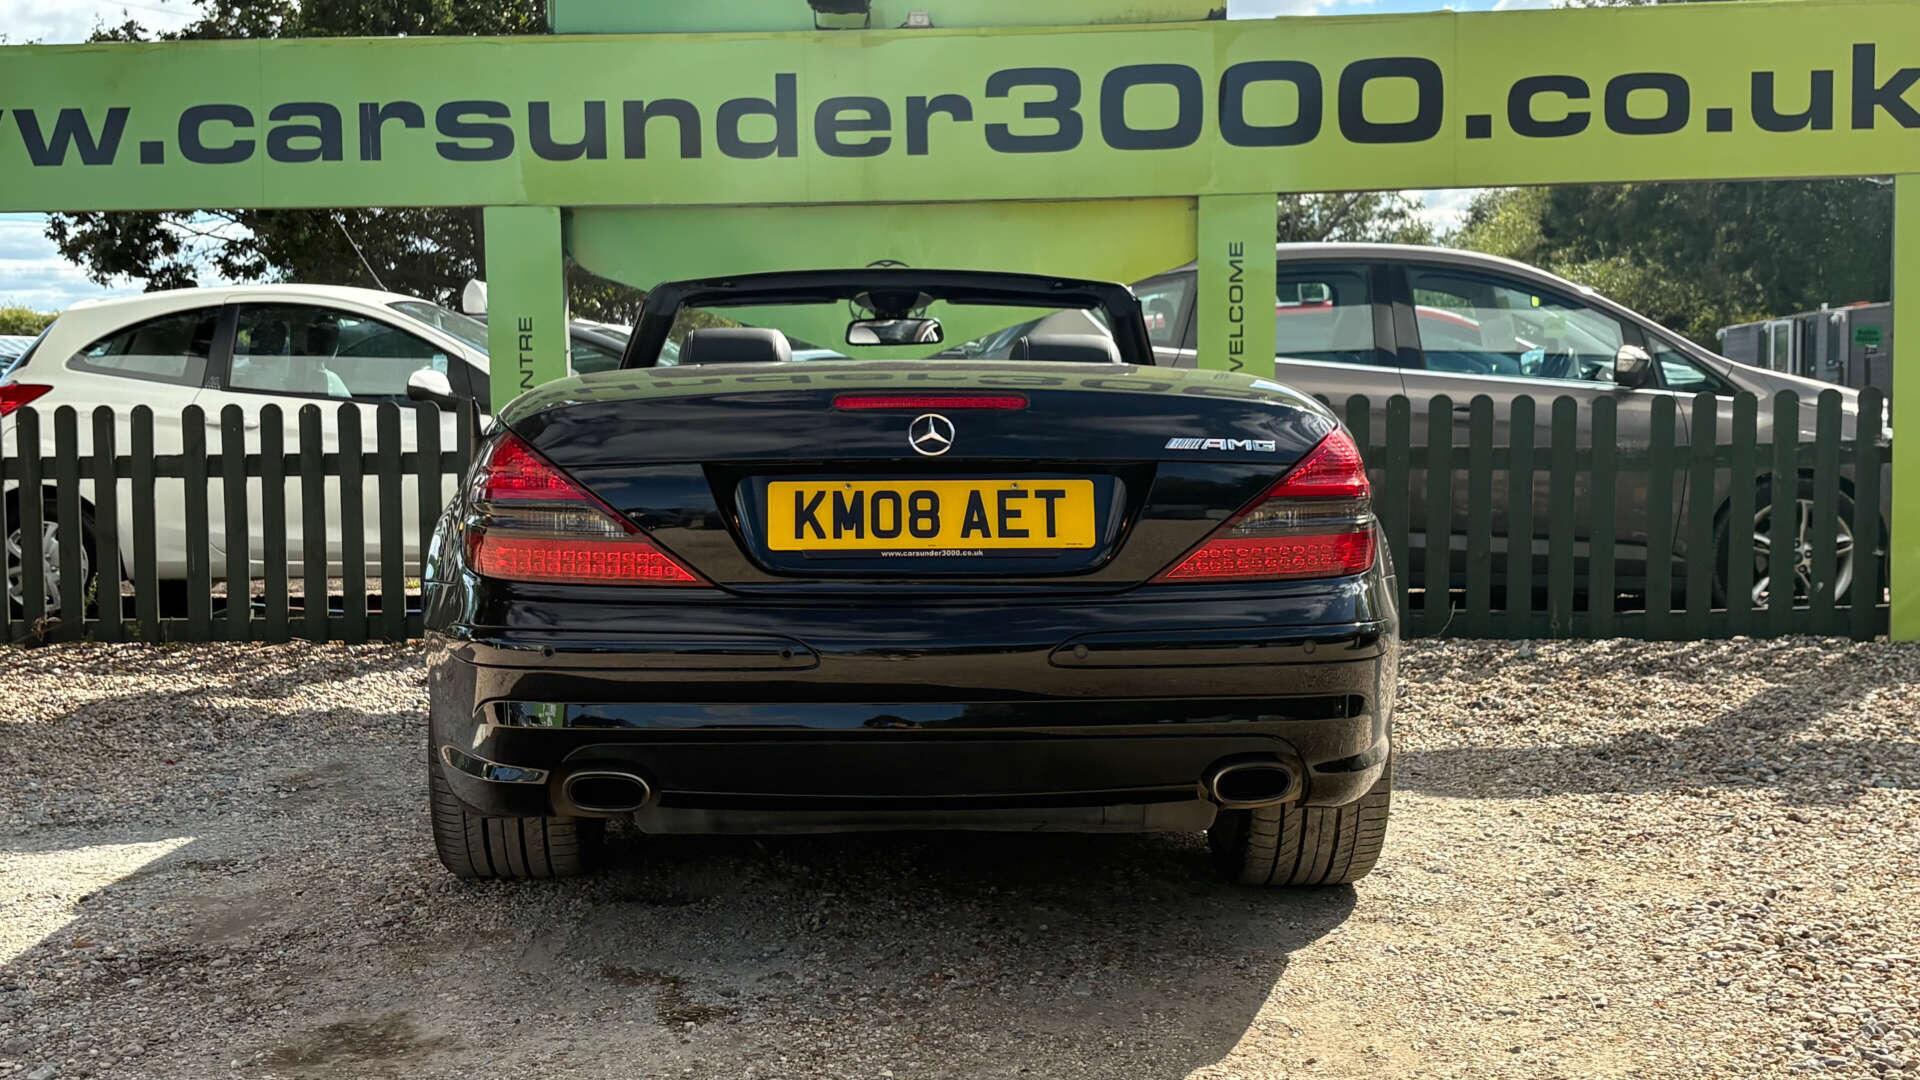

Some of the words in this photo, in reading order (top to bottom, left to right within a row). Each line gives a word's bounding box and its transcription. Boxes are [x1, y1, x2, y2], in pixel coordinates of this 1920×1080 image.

[0, 43, 1920, 167] w.carsunder3000.co.uk
[518, 317, 535, 393] NTRE
[1201, 439, 1276, 452] AMG
[794, 489, 941, 540] KM08
[960, 488, 1066, 539] AET
[880, 548, 984, 557] www.carsunder3000.co.uk
